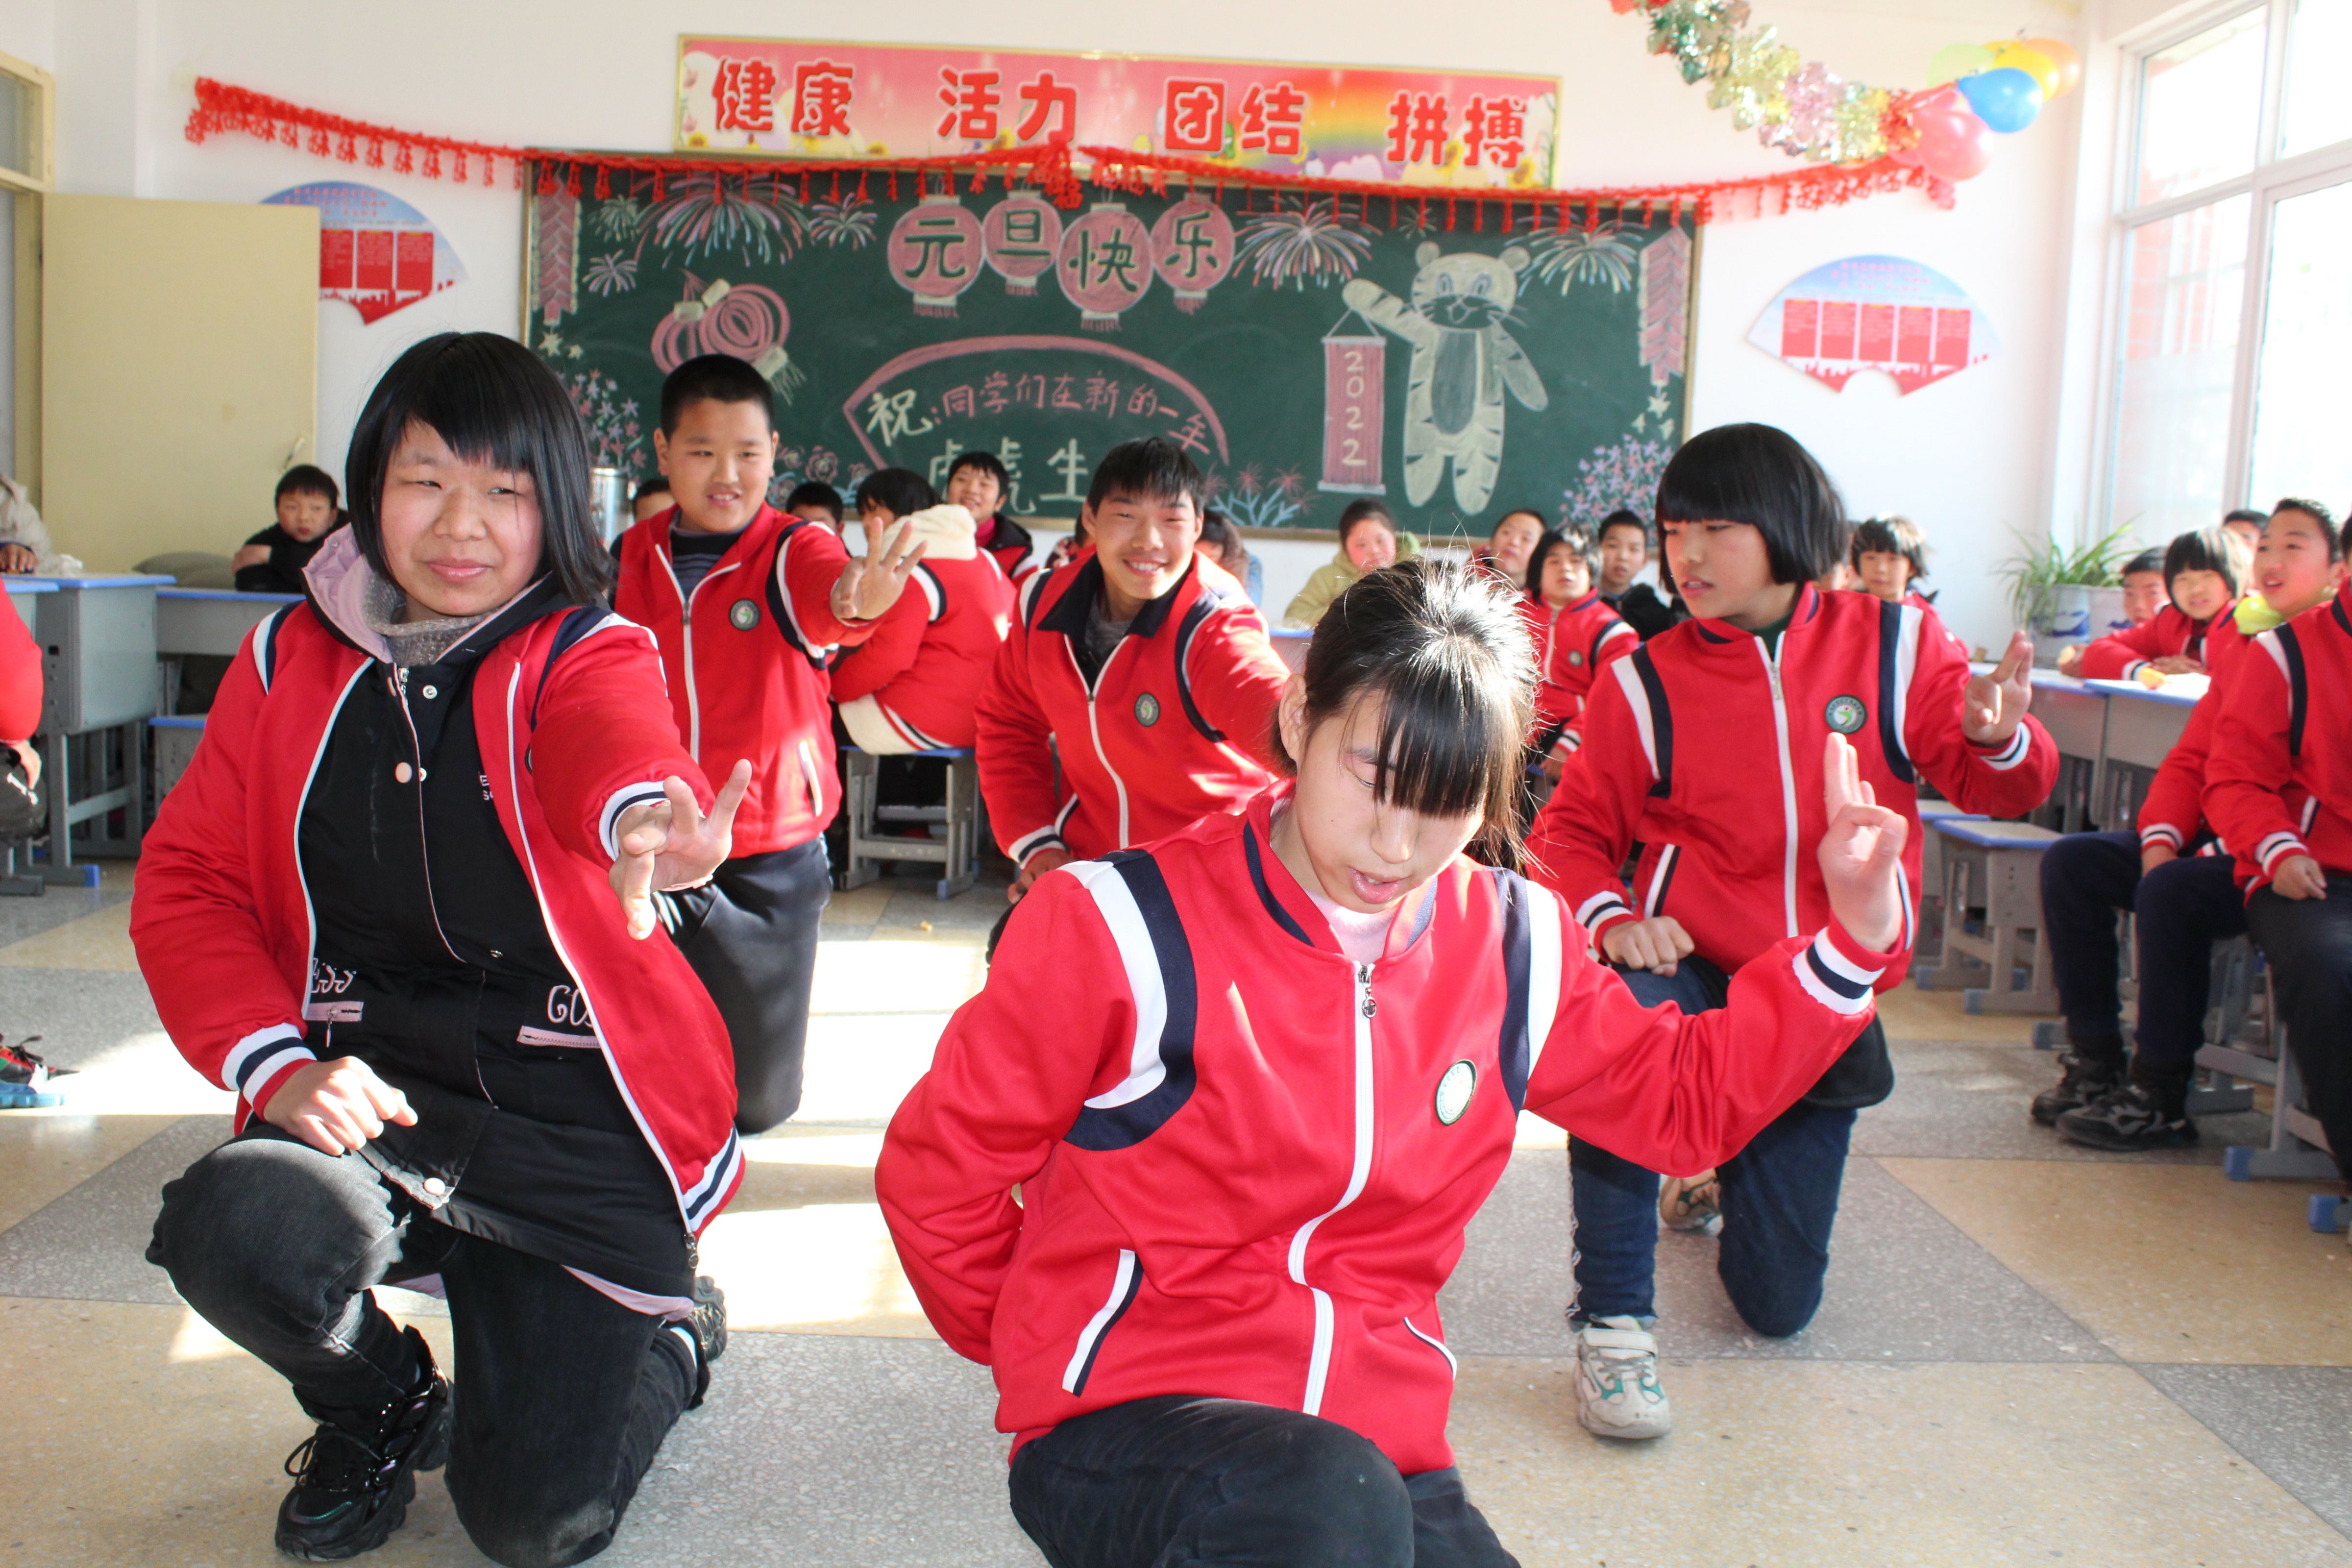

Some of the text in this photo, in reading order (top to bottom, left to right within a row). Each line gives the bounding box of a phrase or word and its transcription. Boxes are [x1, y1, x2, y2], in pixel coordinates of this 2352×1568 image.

[711, 58, 1528, 169] 健康 活力 团结 拼搏
[904, 209, 1218, 293] 元旦快乐
[1342, 351, 1368, 466] 2022
